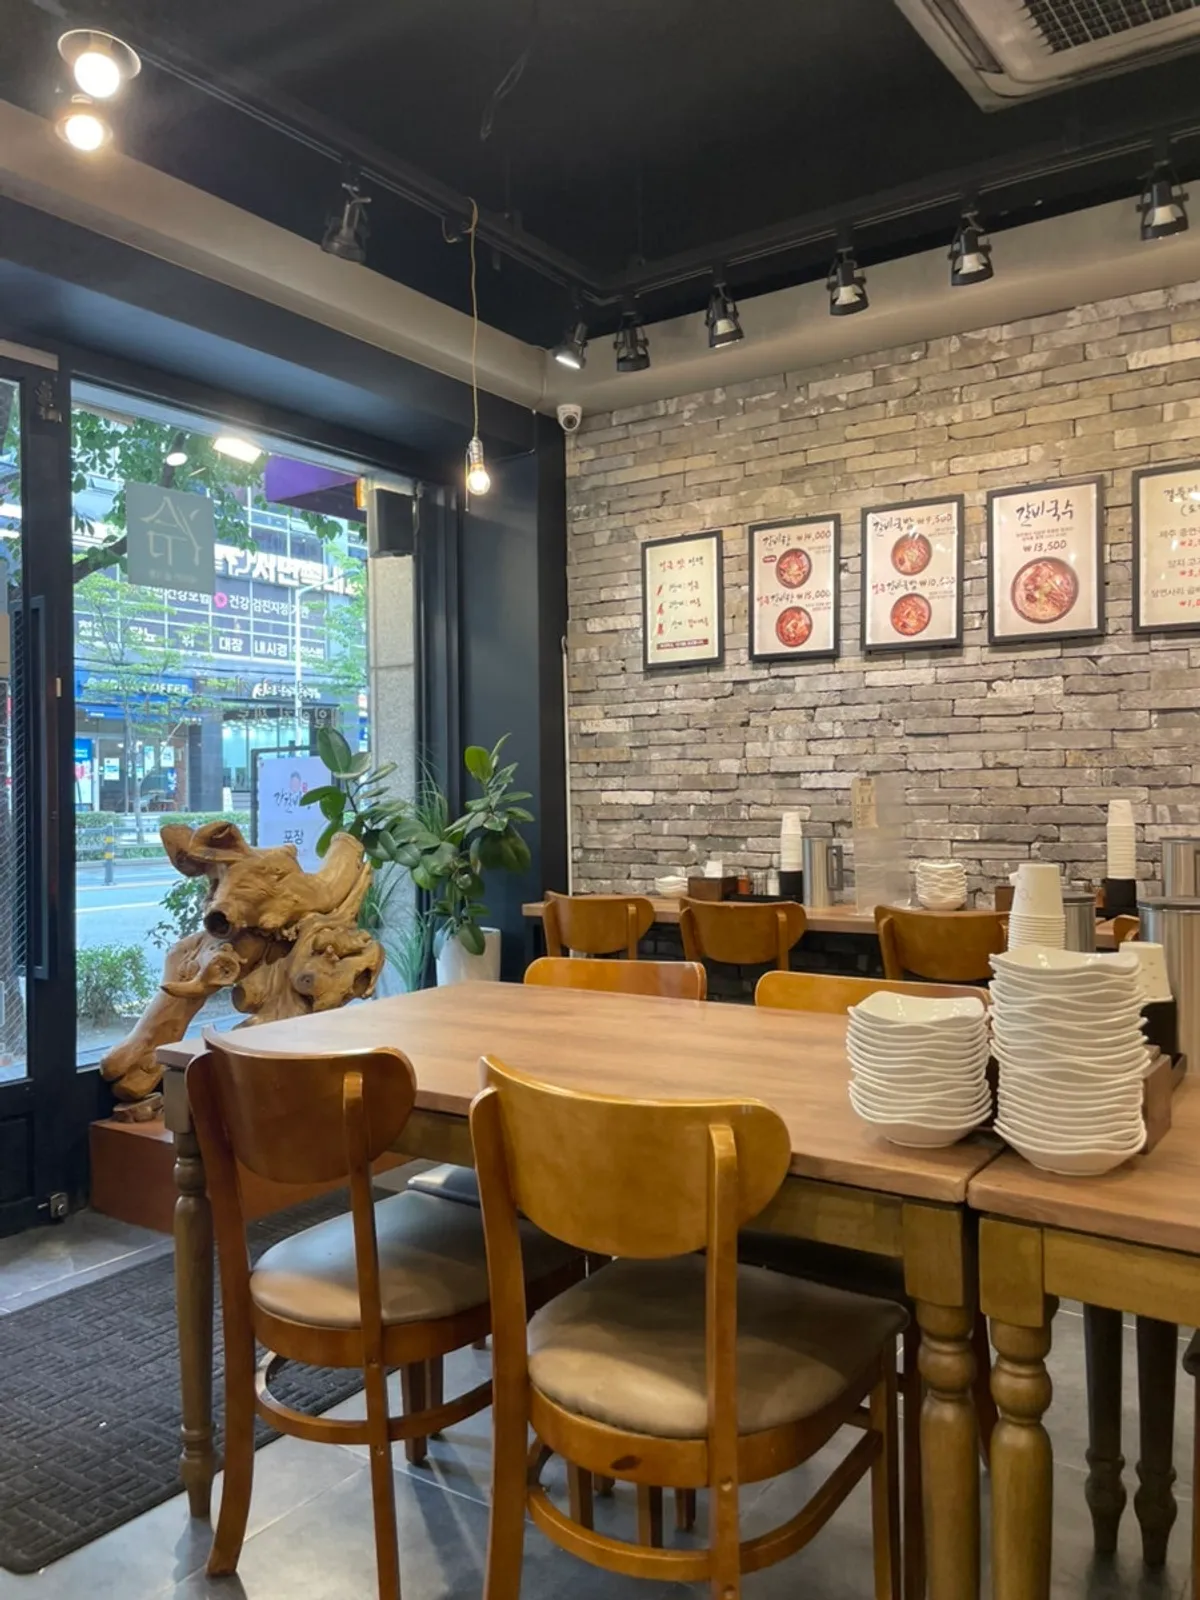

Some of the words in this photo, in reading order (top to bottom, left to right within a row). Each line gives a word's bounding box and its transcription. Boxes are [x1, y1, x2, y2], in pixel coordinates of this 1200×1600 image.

[1015, 498, 1075, 527] 갈비국수
[872, 516, 914, 537] 갈비국밥
[1022, 539, 1068, 552] ₩13,500
[218, 636, 244, 653] 대장
[254, 640, 288, 658] 내시경
[283, 829, 304, 845] 포장
